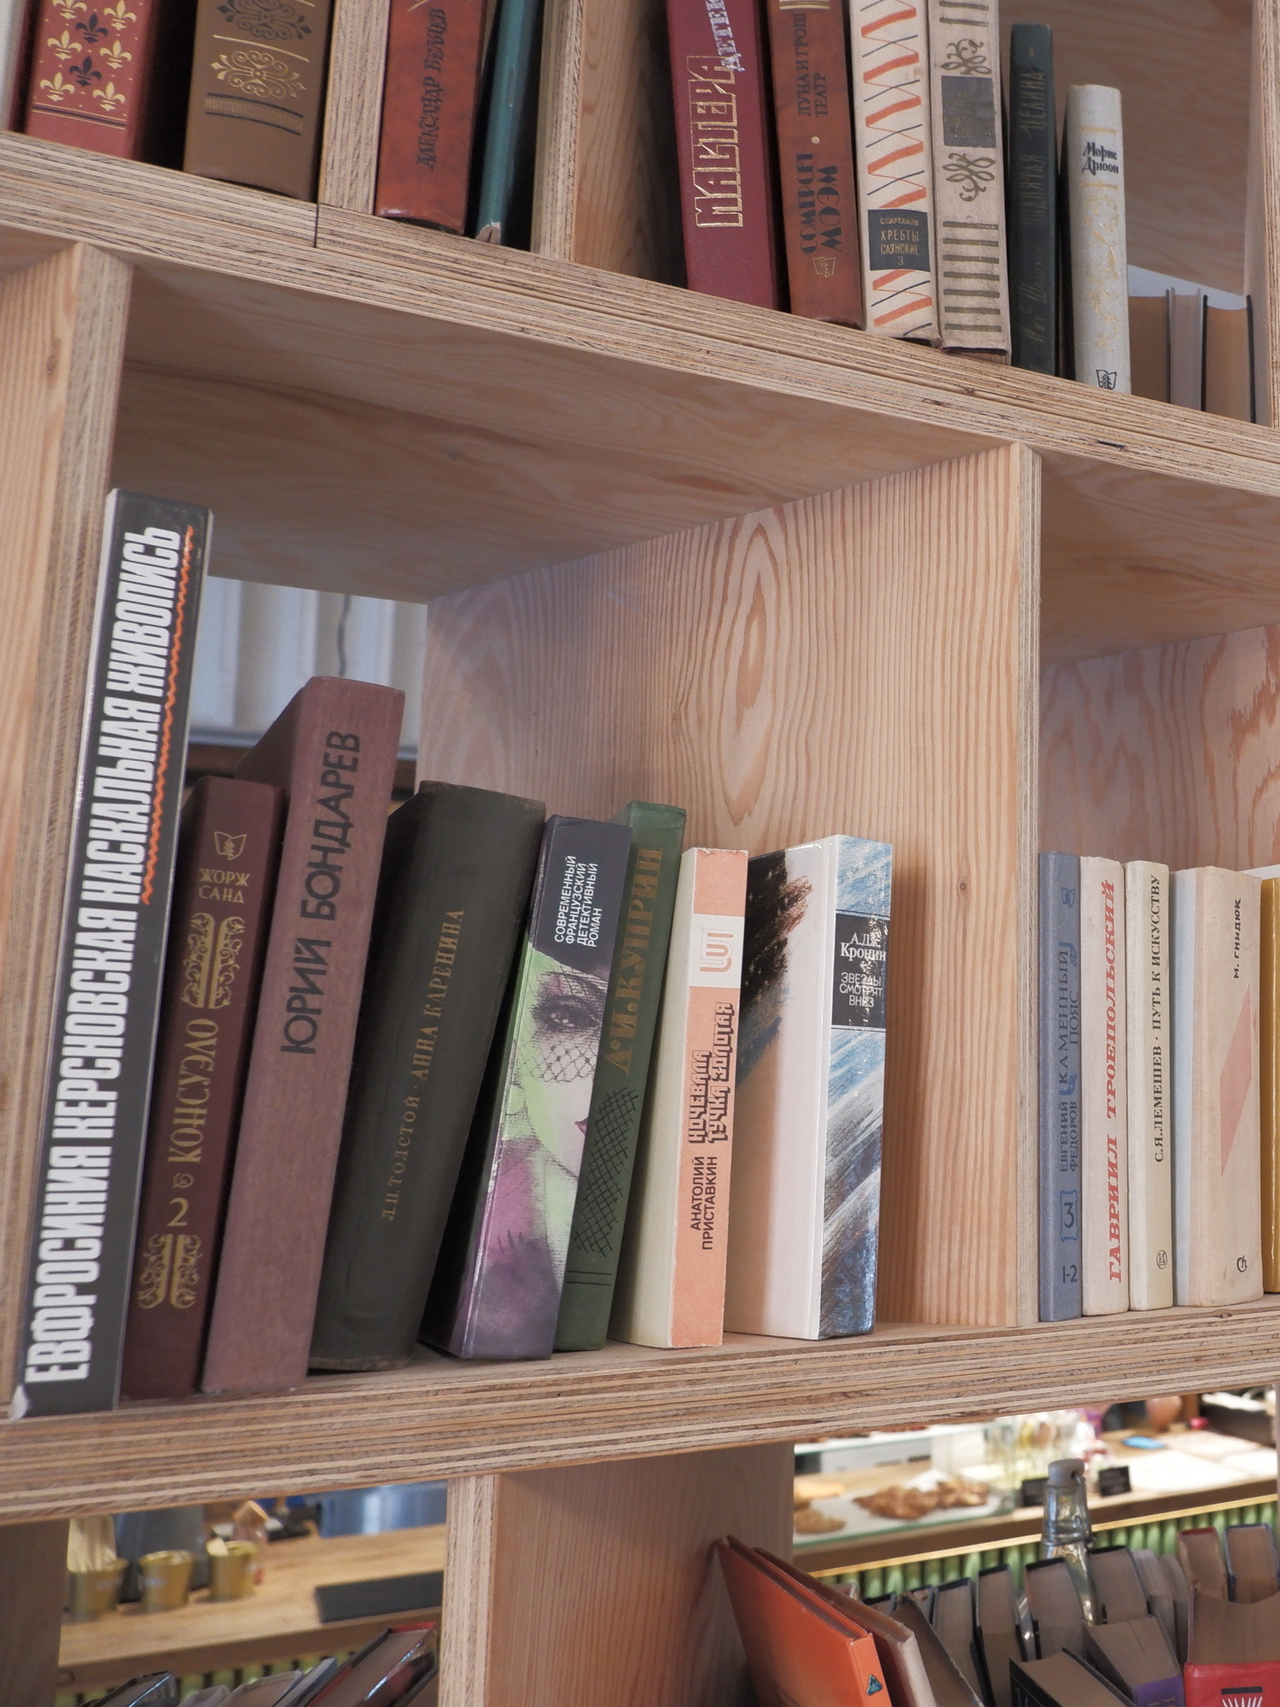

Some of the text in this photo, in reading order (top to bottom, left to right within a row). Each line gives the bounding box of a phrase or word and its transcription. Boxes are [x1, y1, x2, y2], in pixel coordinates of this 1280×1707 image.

[706, 0, 745, 72] ДЕТЕК
[793, 12, 808, 57] ГРОШ
[796, 72, 812, 117] ЛУНА
[812, 72, 828, 118] ТЕАТР
[1082, 156, 1119, 176] Дрюон
[1083, 141, 1118, 161] Морис
[880, 229, 919, 243] ХРЕБТЫ
[880, 242, 920, 256] САЯНСКИЕ
[898, 256, 904, 266] 3
[198, 866, 250, 887] ЖОРЖ
[198, 886, 245, 904] САНД
[281, 730, 361, 1055] ЮРИЙ БОНДАРЕВ
[554, 855, 577, 943] СОВРЕМЕННЫЙ
[565, 862, 587, 945] ФРАНЦУЗСКИЙ
[576, 862, 598, 946] ДЕТЕКТИВНЫЙ
[588, 907, 603, 948] РОМАН
[1150, 873, 1162, 967] ИСКУССТВУ
[1233, 898, 1242, 979] М. ГНИДЮК
[24, 526, 181, 1383] ЕВФРОСИНИЯ КЕРСНОВСКАЯ НАСКАЛЬНАЯ ЖИВОПИСЬ
[423, 909, 464, 1017] КАРЕНИНА
[840, 942, 887, 961] Кронин
[840, 971, 882, 987] ЗВЕЗДЫ
[1152, 971, 1162, 981] К
[839, 983, 883, 997] СМОТРЯТ
[1057, 949, 1070, 1085] КАМЕННЫЙ
[1067, 990, 1079, 1045] ПОЯС
[1152, 988, 1163, 1030] ПУТЬ
[410, 1025, 439, 1081] АННА
[706, 1002, 734, 1144] ТУЧКА ЗОЛОТАЯ
[166, 1017, 219, 1164] КОНСУЭЛО
[687, 1049, 709, 1144] НОЧЕВАЛА
[1099, 879, 1122, 1284] ГАВРИИЛ ТРОЕПОЛЬСКИЙ
[1059, 1101, 1069, 1173] ЕВГЕНИЙ
[1068, 1101, 1079, 1173] ФЕДОРОВ
[167, 1196, 189, 1227] 2
[690, 1156, 705, 1231] АНАТОЛИЙ
[701, 1156, 718, 1251] ПРИСТАВКИН
[1063, 1200, 1077, 1228] 3
[1061, 1264, 1078, 1284] 1-2
